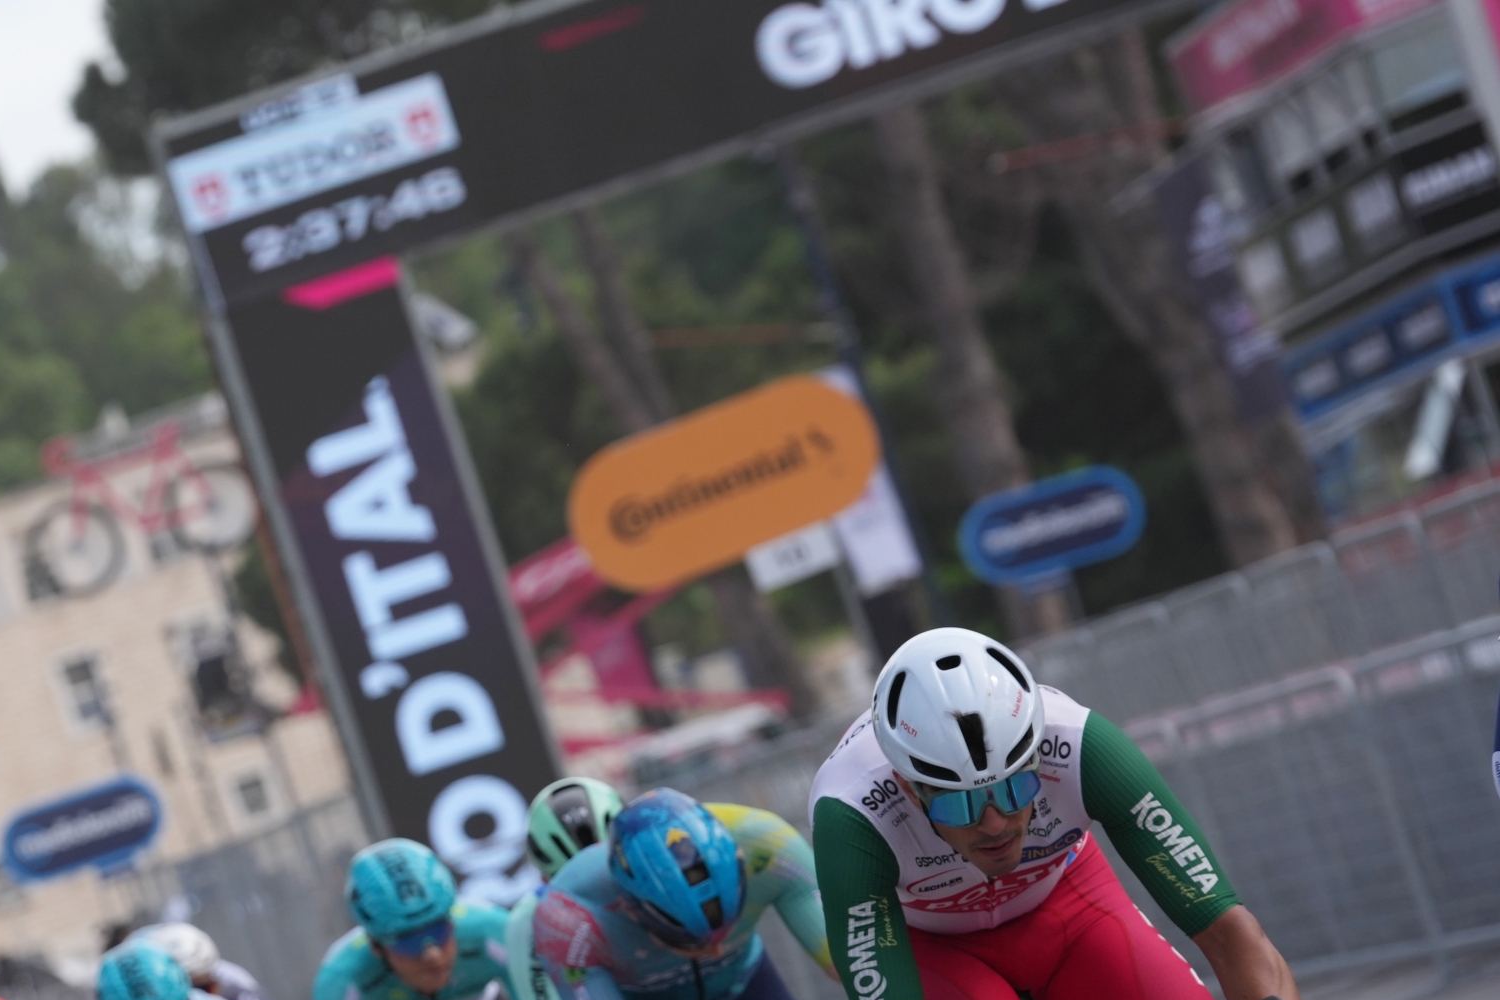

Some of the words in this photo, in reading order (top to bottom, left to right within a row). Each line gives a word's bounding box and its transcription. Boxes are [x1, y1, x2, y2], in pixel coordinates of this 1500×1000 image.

[235, 118, 398, 196] TUDOR
[608, 433, 808, 545] Continental
[900, 719, 918, 738] POLTI
[1038, 734, 1072, 759] olo
[974, 775, 997, 786] KASK
[861, 779, 899, 811] solo
[1027, 817, 1062, 838] KODA
[1130, 791, 1219, 894] KOMETA
[918, 876, 963, 893] LECHLER
[925, 863, 1062, 910] POLTI
